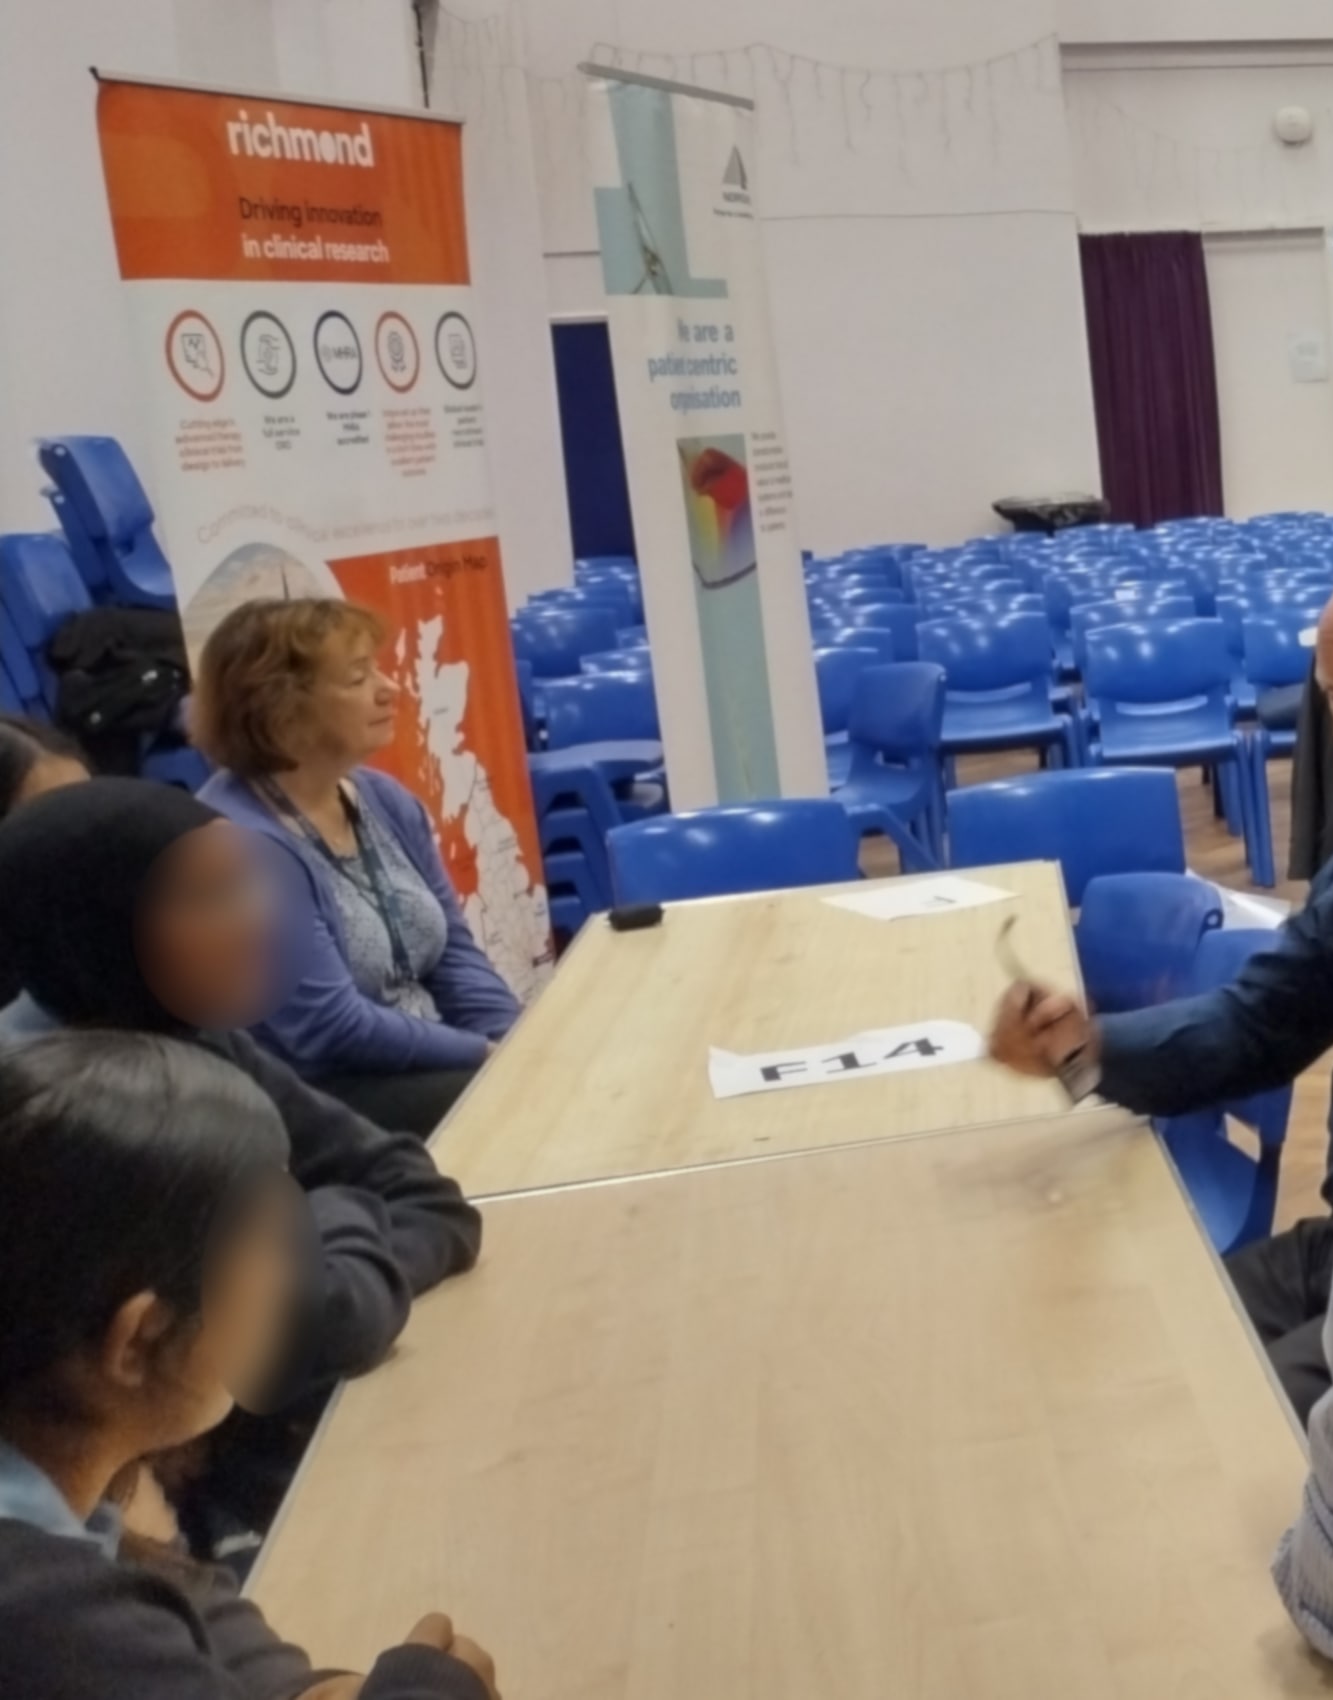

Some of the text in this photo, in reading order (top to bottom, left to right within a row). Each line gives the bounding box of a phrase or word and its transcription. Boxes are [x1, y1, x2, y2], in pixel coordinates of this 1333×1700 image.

[227, 108, 375, 168] richmond
[239, 197, 382, 228] Driving innovation
[241, 233, 390, 263] in clinical research
[693, 325, 718, 342] are
[724, 324, 734, 342] a
[760, 1037, 945, 1083] F14
